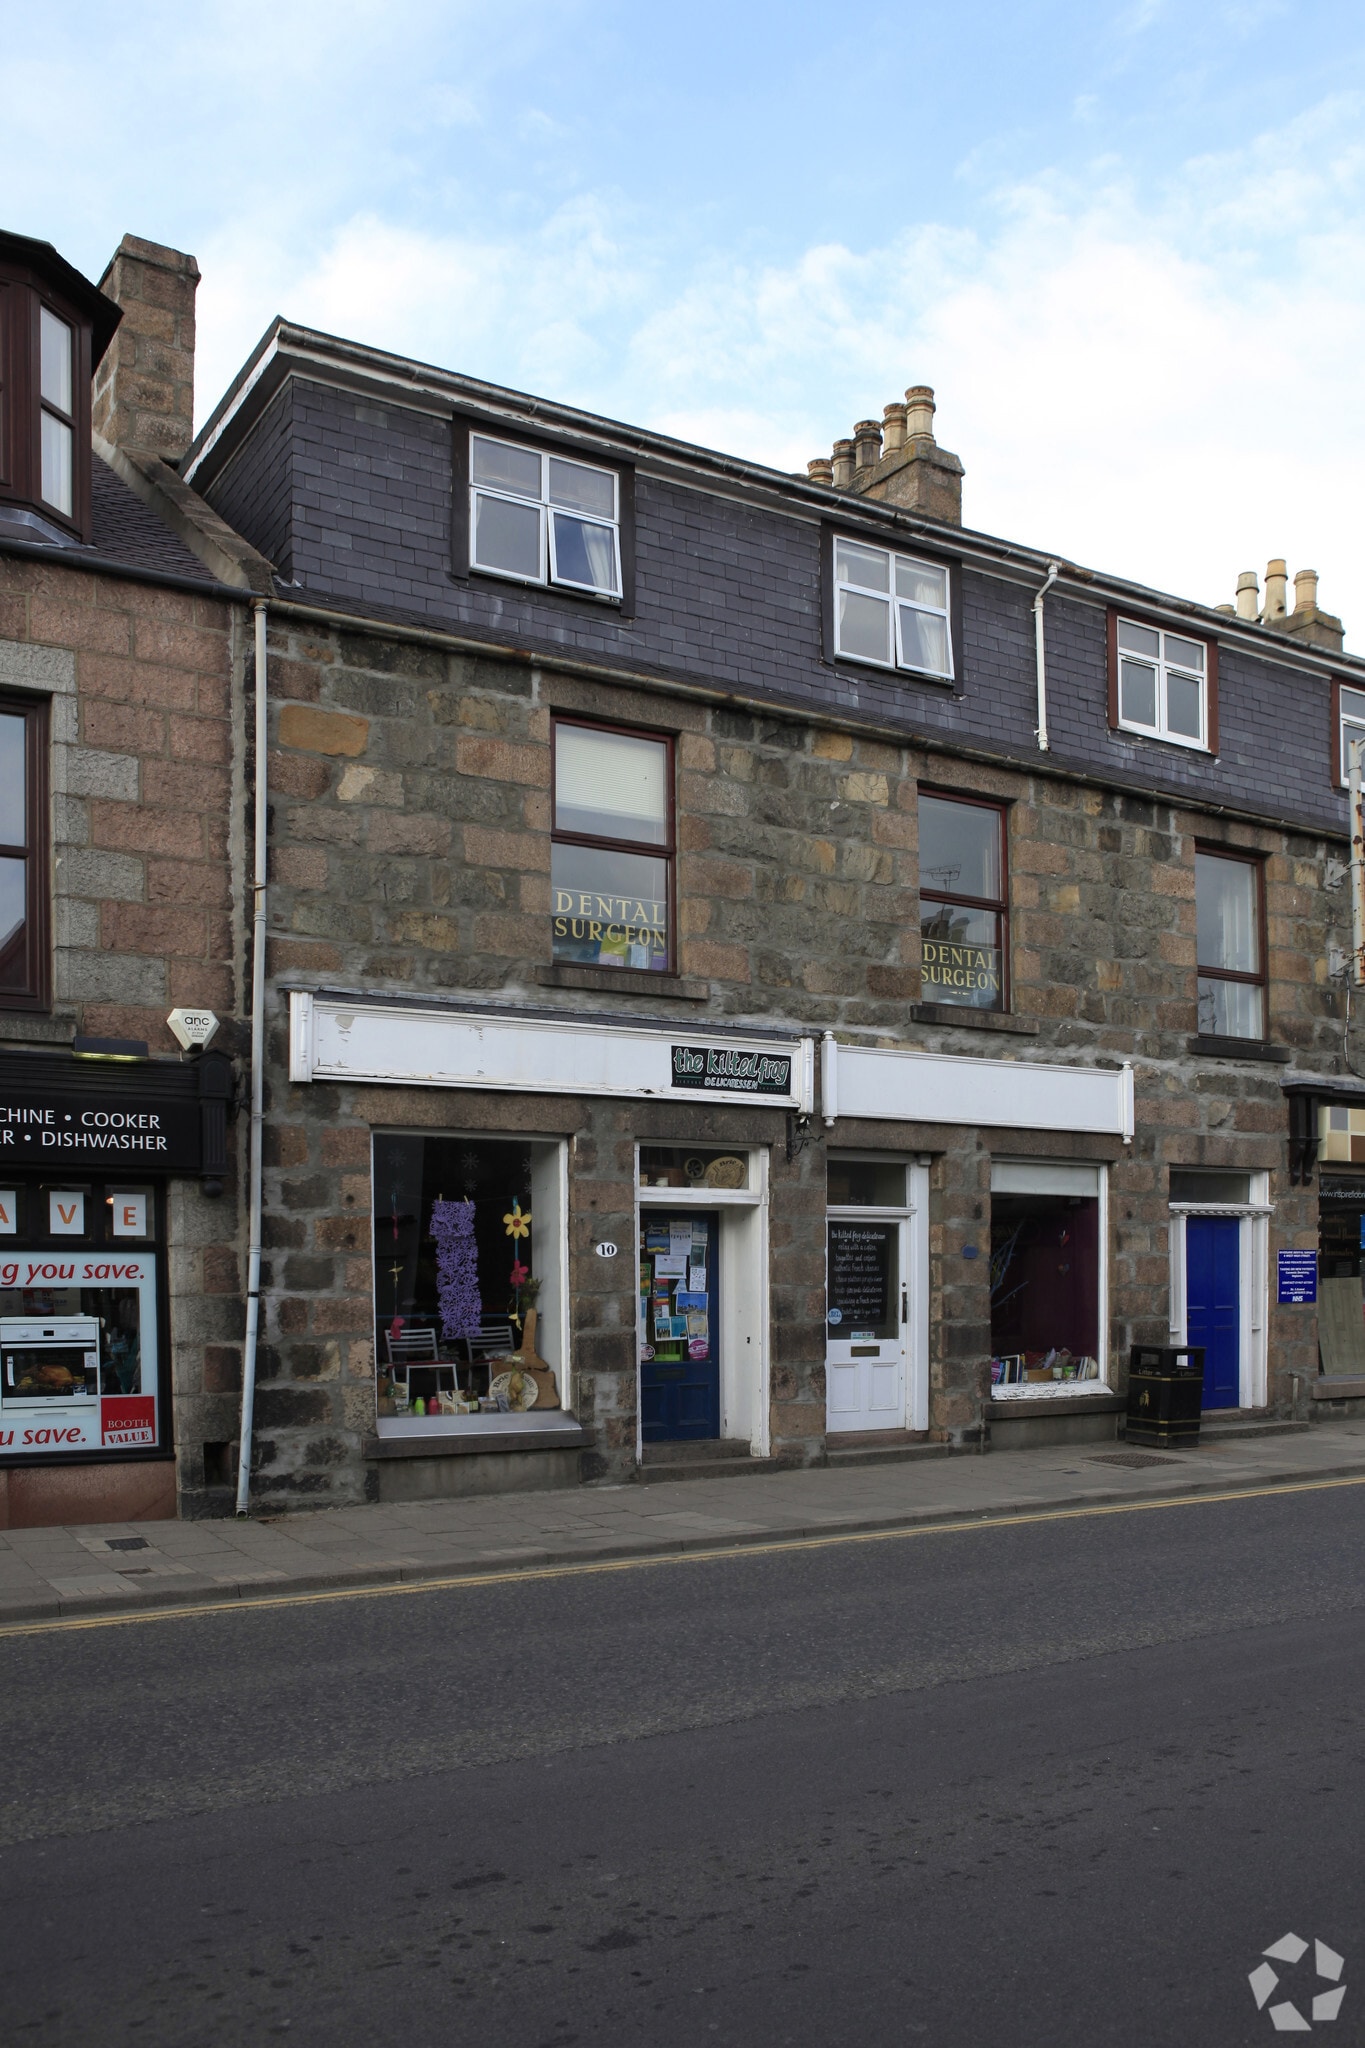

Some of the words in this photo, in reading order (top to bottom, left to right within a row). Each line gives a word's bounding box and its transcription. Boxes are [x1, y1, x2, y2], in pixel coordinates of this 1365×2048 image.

[555, 891, 665, 925] DENTAL
[554, 917, 666, 948] SURGEON
[923, 943, 997, 970] DENTAL
[921, 964, 1000, 991] SURGEON
[184, 1016, 210, 1026] anc
[674, 1047, 704, 1073] the
[706, 1048, 759, 1077] kilted
[757, 1056, 789, 1086] frog
[704, 1076, 759, 1090] DELICATESSEN
[81, 1111, 160, 1129] COOKER
[41, 1131, 168, 1150] DISHWASHER
[57, 1204, 77, 1224] V
[123, 1206, 137, 1226] E
[601, 1244, 615, 1256] 10
[0, 1263, 19, 1286] g
[25, 1264, 75, 1286] you
[82, 1263, 145, 1280] save.
[107, 1418, 149, 1429] BOOTH
[22, 1427, 87, 1445] save.
[108, 1430, 149, 1444] VALUE
